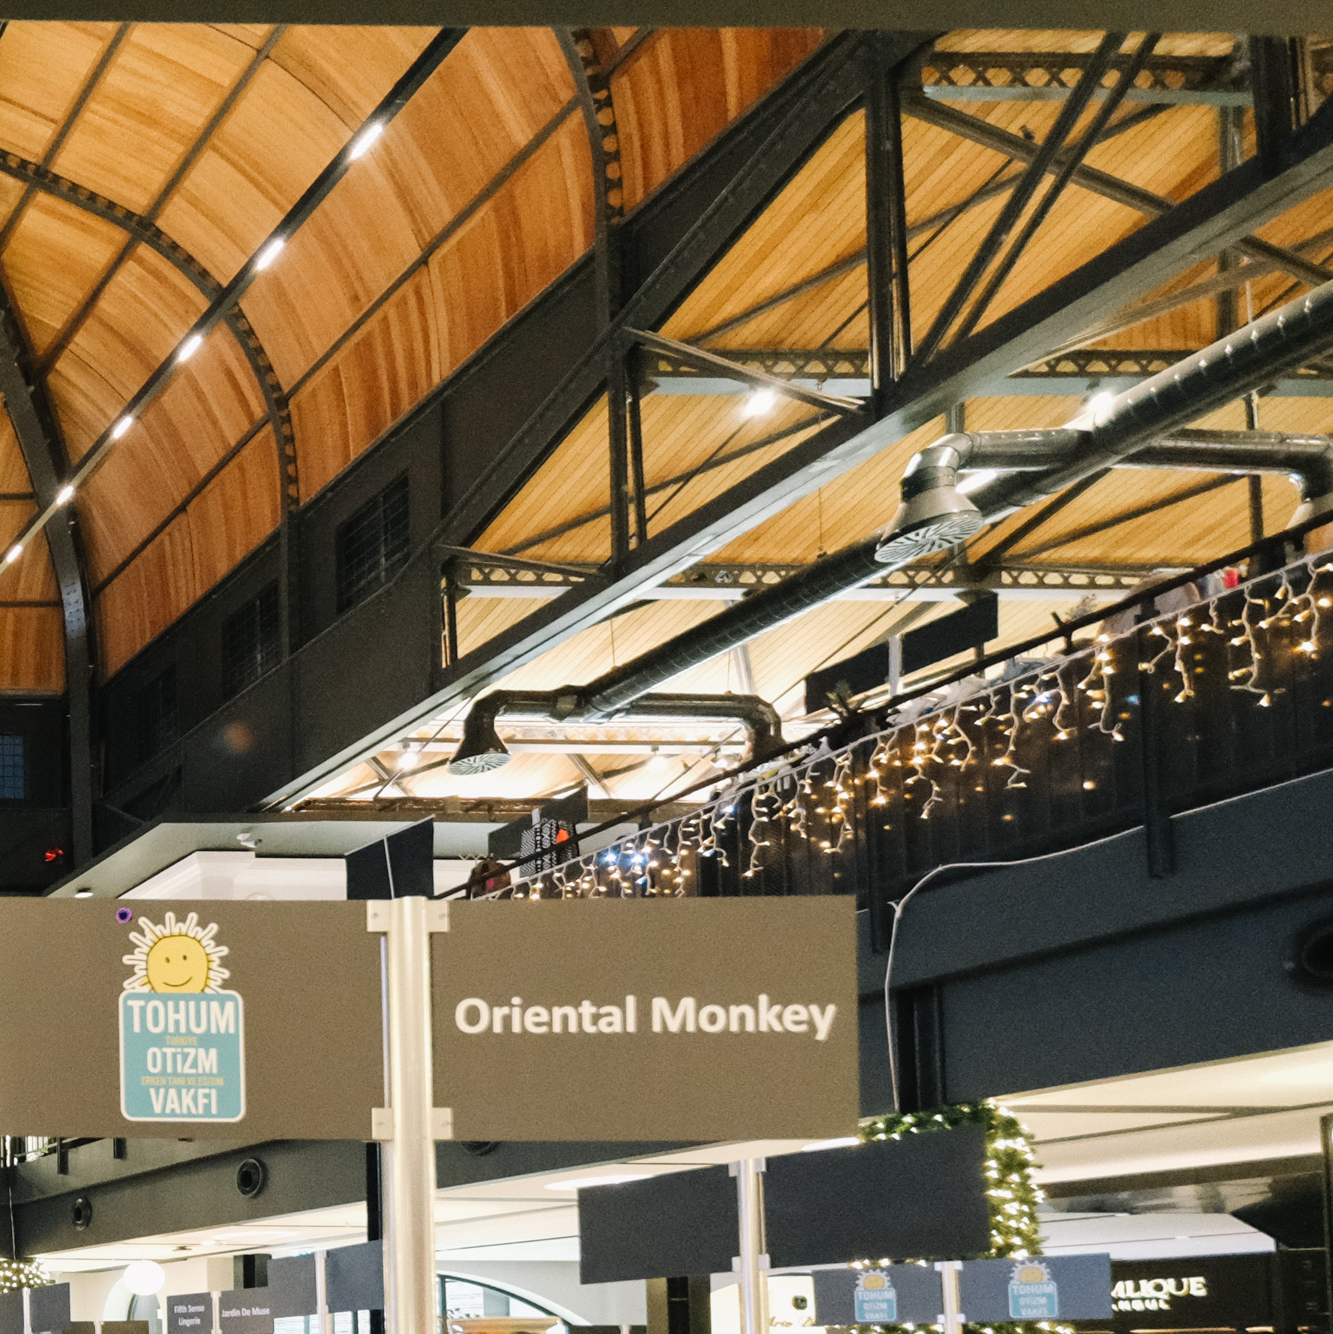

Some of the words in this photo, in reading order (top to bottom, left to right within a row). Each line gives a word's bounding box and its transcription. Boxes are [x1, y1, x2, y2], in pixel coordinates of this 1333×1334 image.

[127, 999, 236, 1035] TOHUM
[455, 995, 636, 1035] Oriental
[651, 995, 836, 1041] Monkey
[149, 1088, 218, 1115] VAKFI
[857, 1290, 894, 1301] TOHUM
[1013, 1283, 1055, 1295] TOHUM
